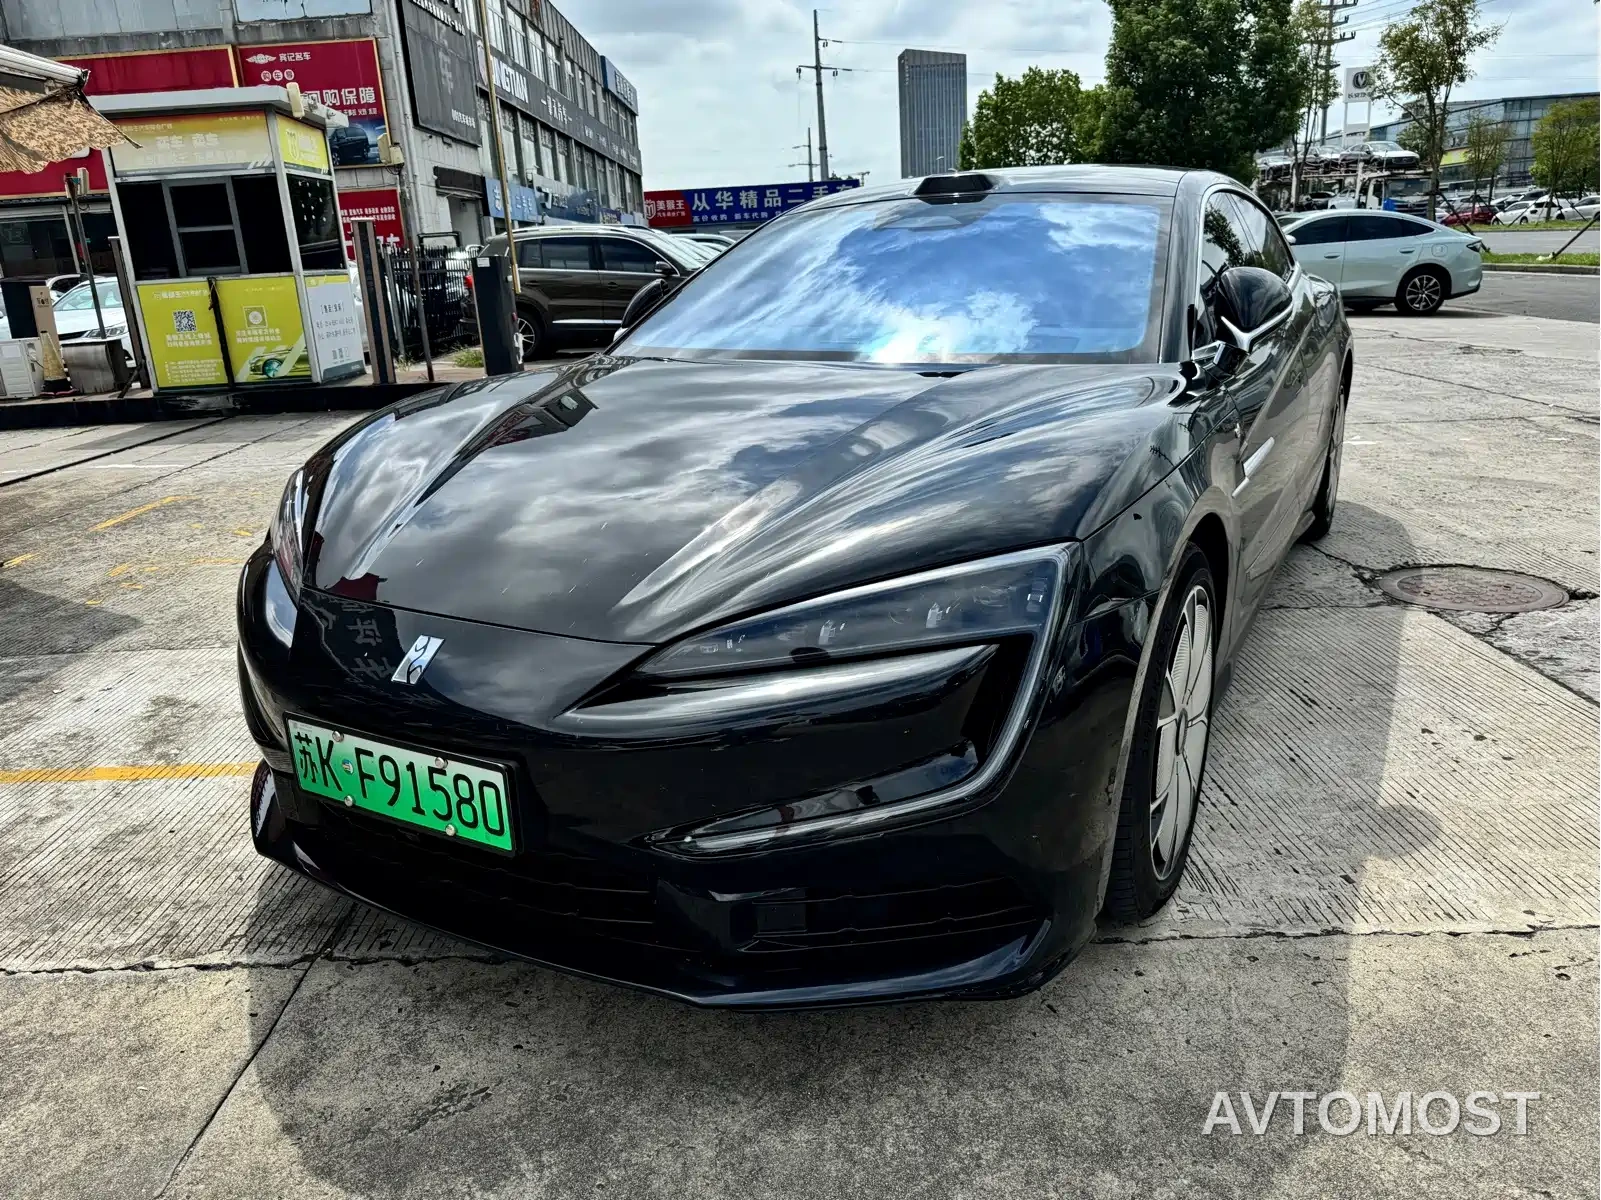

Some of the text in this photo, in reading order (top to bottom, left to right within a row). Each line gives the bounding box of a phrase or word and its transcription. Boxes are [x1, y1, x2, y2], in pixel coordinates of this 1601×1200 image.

[656, 199, 686, 212] 美猴王
[692, 184, 853, 212] 从华精品二手
[692, 213, 728, 223] 高价收购
[294, 732, 506, 837] 苏K F91580
